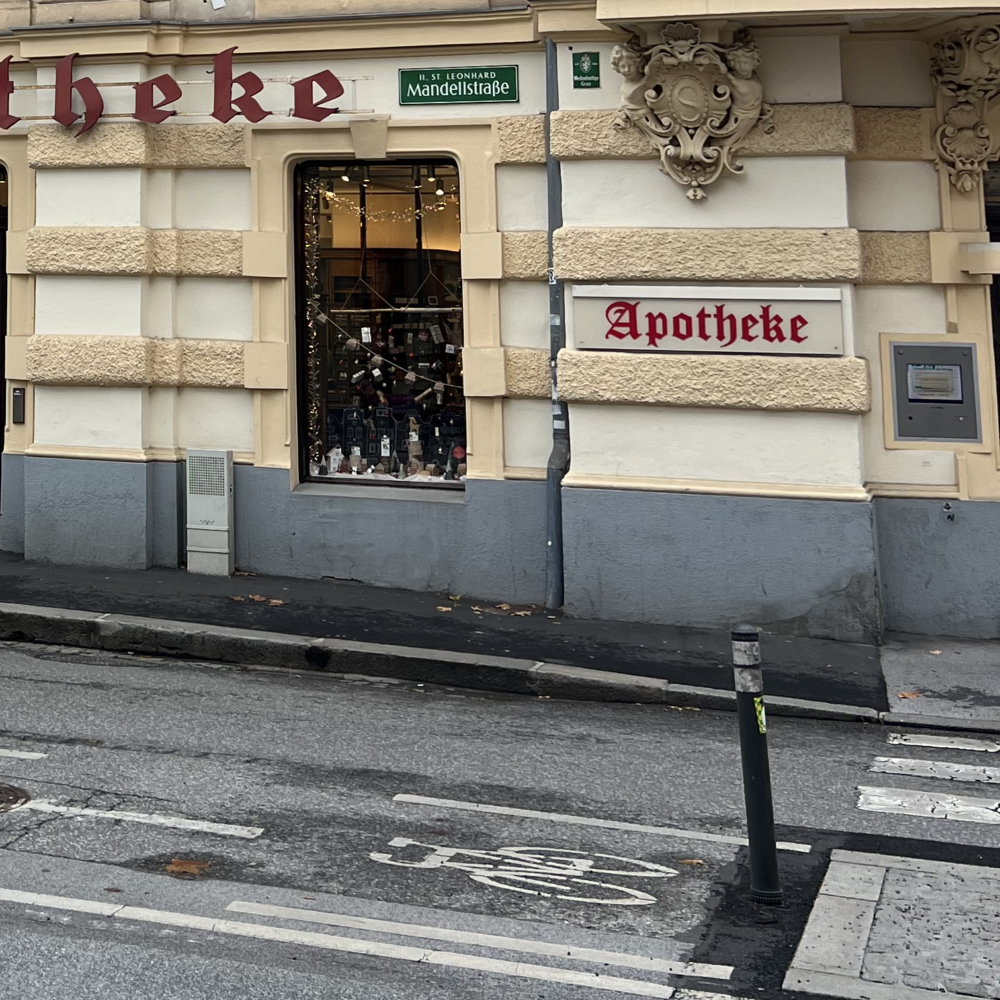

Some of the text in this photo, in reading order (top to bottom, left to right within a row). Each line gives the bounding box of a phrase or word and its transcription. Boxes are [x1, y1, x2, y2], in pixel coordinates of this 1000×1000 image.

[446, 71, 497, 80] LEONHARD
[406, 80, 510, 97] Mandellstraße
[604, 301, 809, 348] Apotheke
